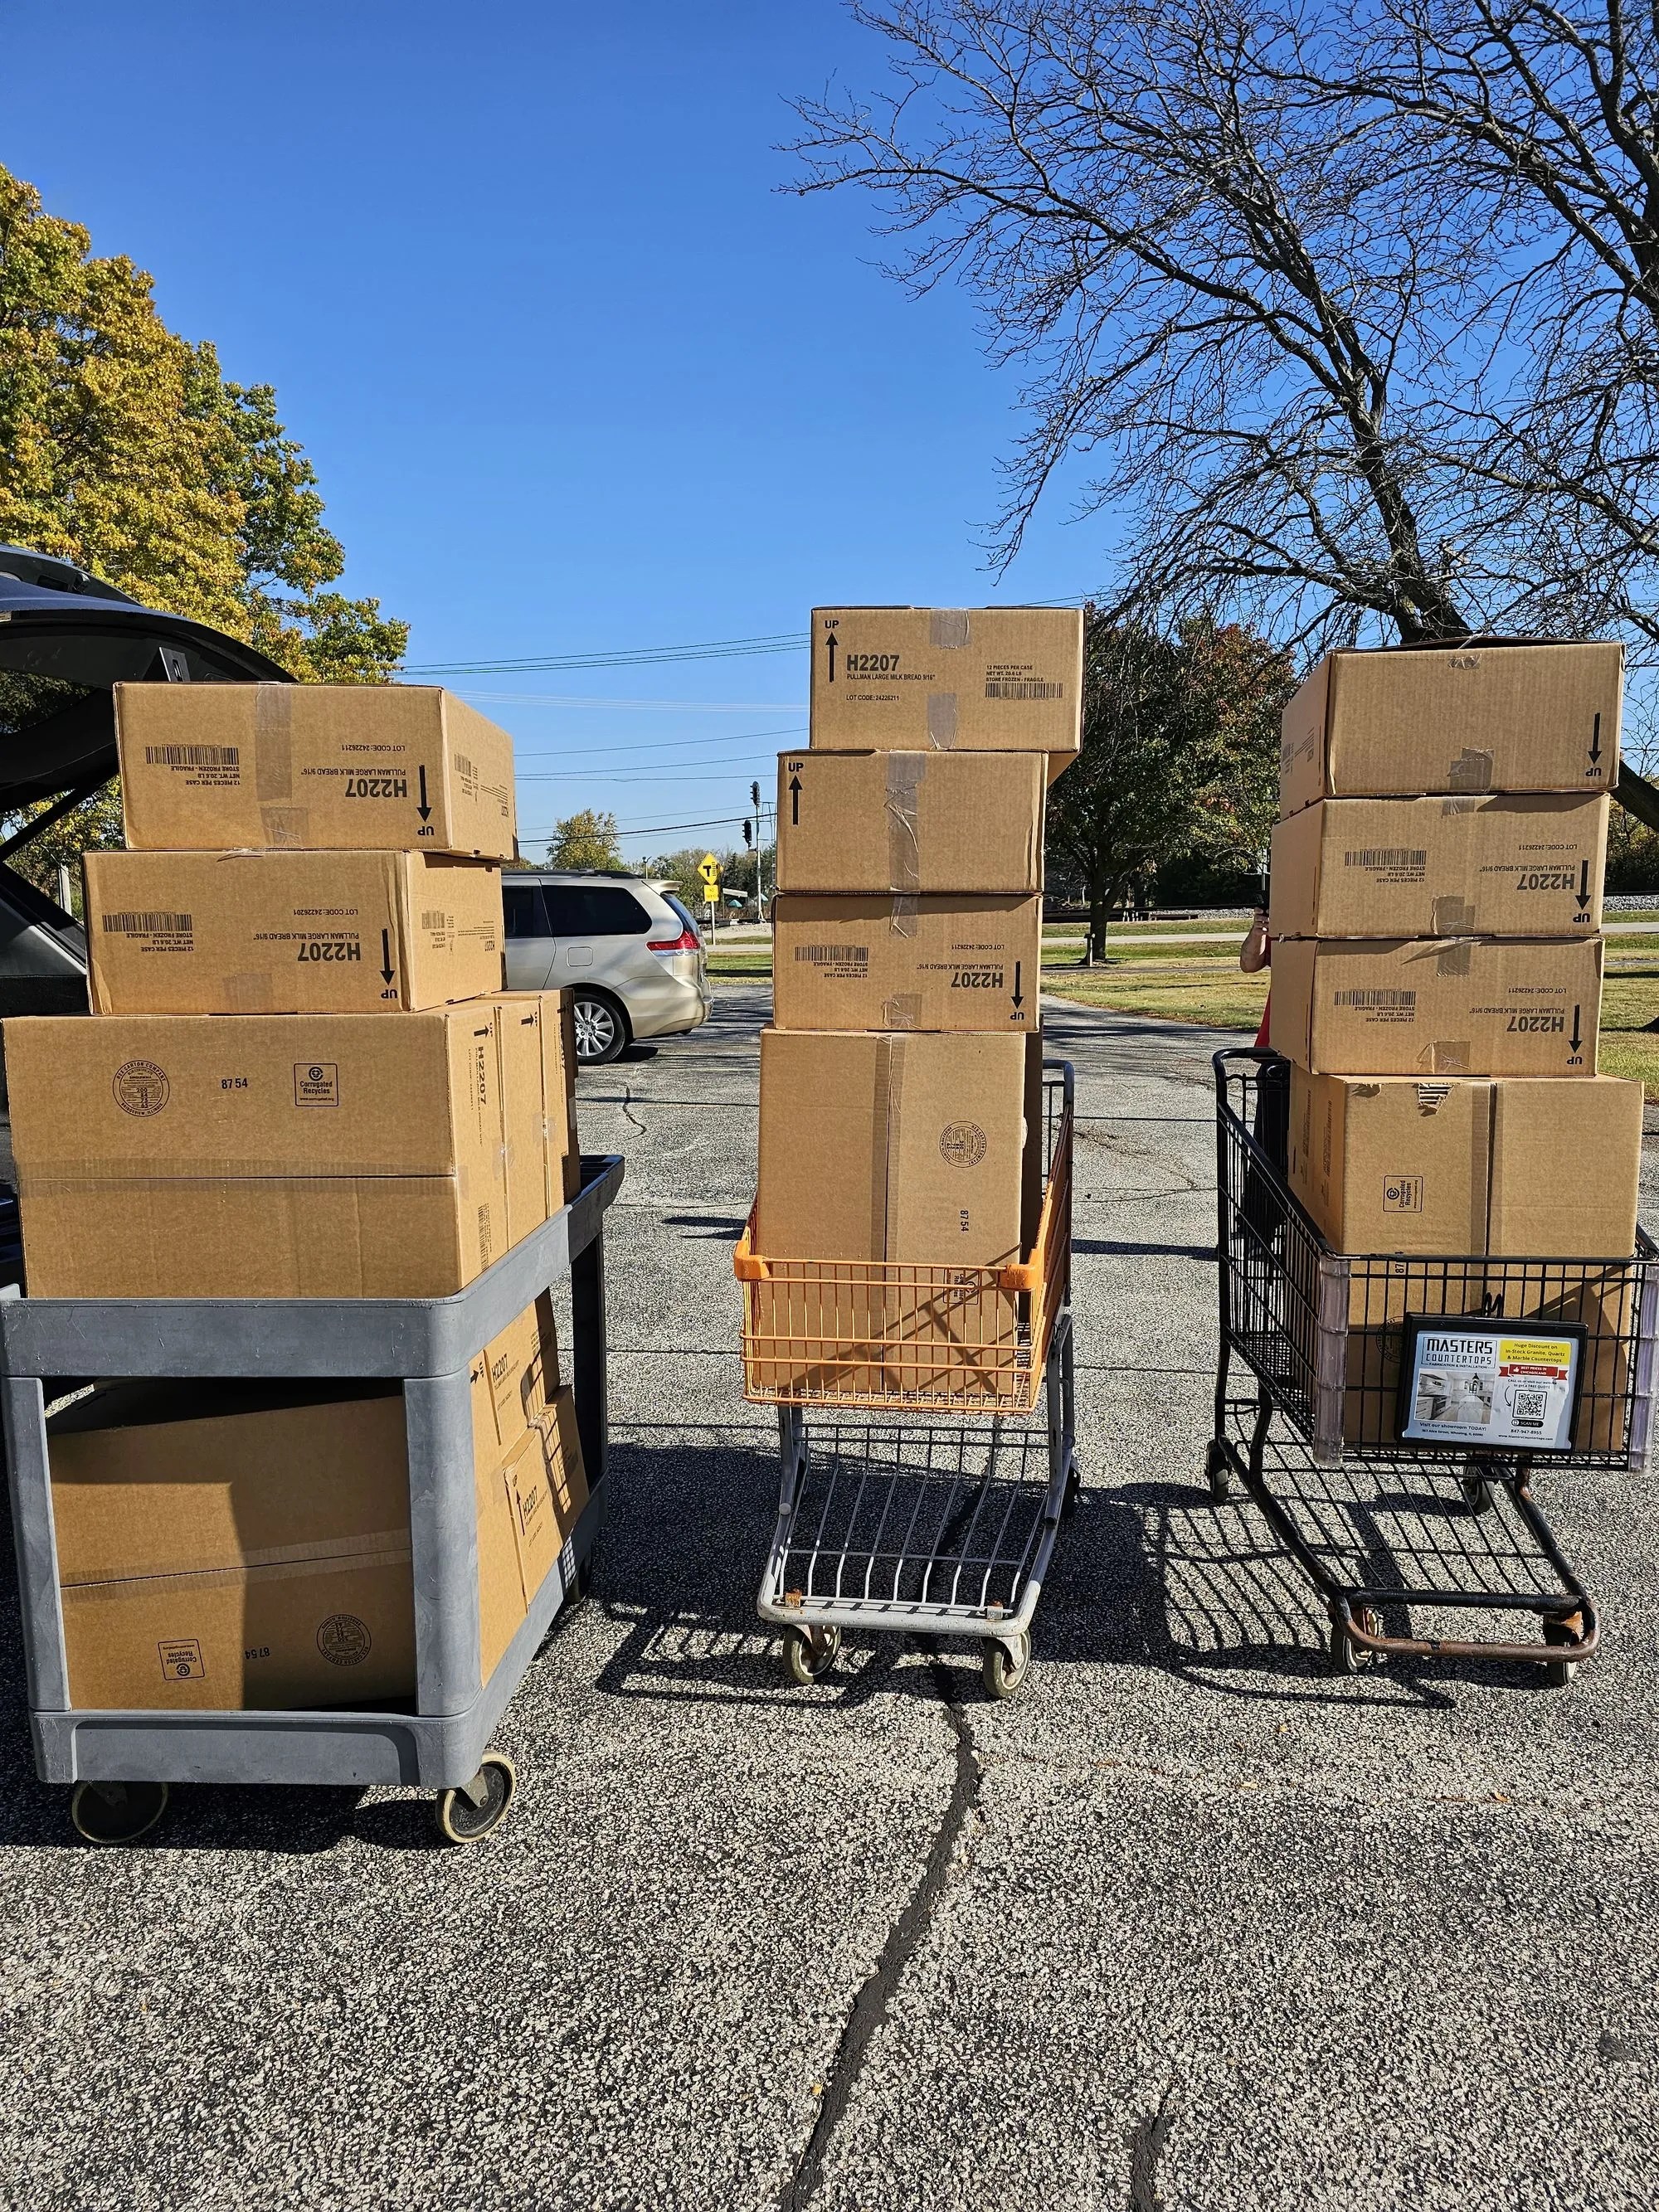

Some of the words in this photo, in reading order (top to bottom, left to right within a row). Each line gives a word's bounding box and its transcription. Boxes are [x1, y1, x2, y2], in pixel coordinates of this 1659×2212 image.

[825, 620, 839, 629] UP
[846, 654, 900, 672] H2207
[788, 762, 804, 772] UP
[1585, 767, 1602, 777] UP
[344, 779, 408, 798] H2207
[417, 825, 435, 836] UP
[1516, 873, 1575, 890] H2207
[1573, 913, 1590, 923] UP
[297, 942, 361, 961] H2207
[951, 972, 1004, 988] H2207
[381, 989, 398, 999] UP
[1010, 1012, 1024, 1020] UP
[1506, 1016, 1564, 1033] H2207
[1566, 1056, 1583, 1065] UP
[124, 1062, 144, 1071] CARTON
[145, 1062, 166, 1082] COMPANY
[478, 1046, 487, 1105] H2207
[1427, 1339, 1493, 1354] MASTERS
[1426, 1354, 1491, 1365] COUNTERTOPS
[166, 1656, 197, 1665] Corrugated
